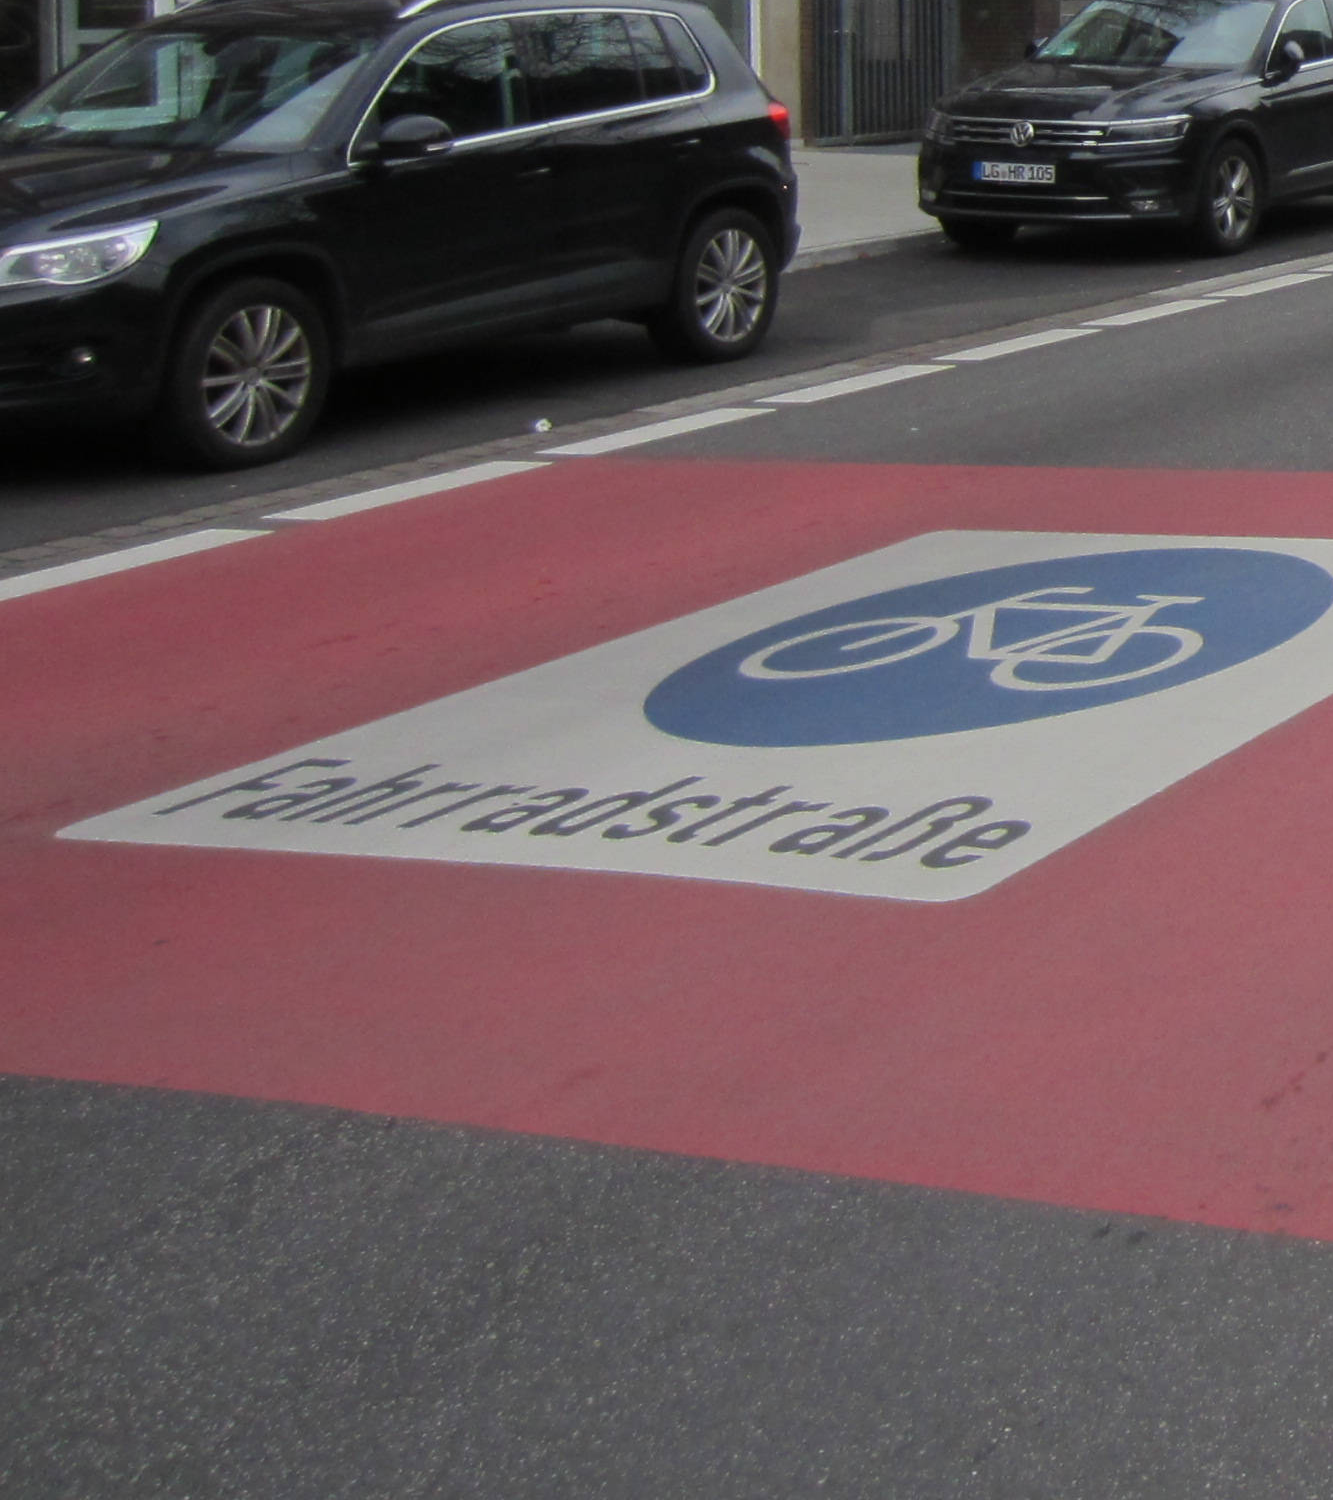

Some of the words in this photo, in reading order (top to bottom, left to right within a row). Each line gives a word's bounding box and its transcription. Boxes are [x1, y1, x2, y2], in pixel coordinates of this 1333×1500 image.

[982, 163, 1000, 179] LG
[1007, 164, 1025, 180] HR
[1027, 165, 1054, 181] 105
[153, 757, 1034, 872] Fahrradstraße
